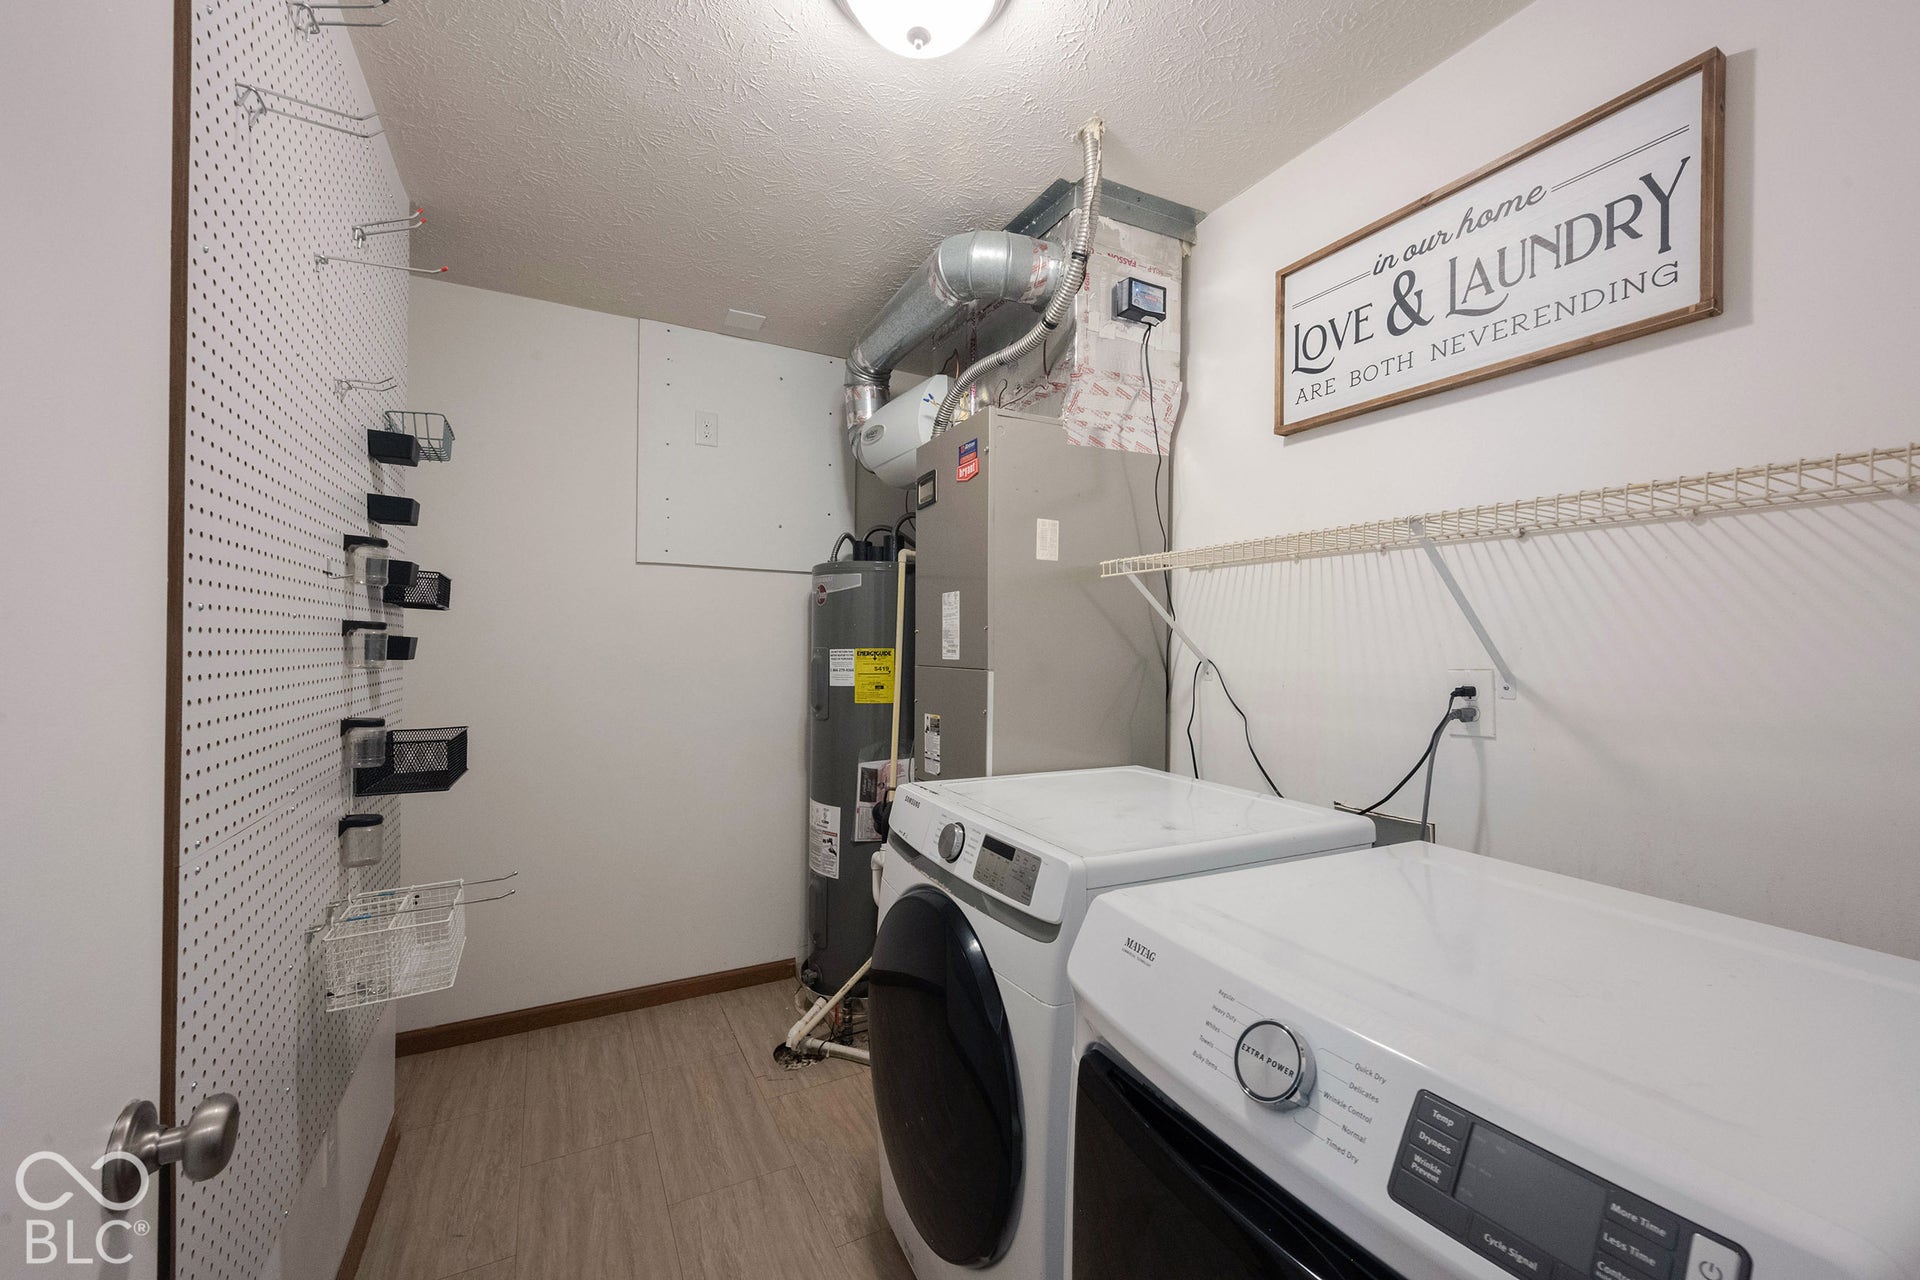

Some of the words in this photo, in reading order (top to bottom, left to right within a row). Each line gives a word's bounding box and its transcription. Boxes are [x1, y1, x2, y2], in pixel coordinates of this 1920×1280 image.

[1373, 254, 1399, 275] in
[1403, 231, 1453, 261] our
[1456, 185, 1547, 239] home
[1292, 303, 1374, 374] LOVE
[1386, 270, 1434, 336] &
[1446, 155, 1690, 318] LAUNDRY
[1295, 378, 1336, 405] ARE
[1350, 351, 1414, 387] BOTH
[1430, 261, 1679, 362] NEVERENDING
[905, 794, 921, 808] SAMSUNG
[1125, 937, 1157, 962] MAYTAG
[1218, 989, 1236, 1002] Regular
[1212, 1004, 1226, 1017] Heavy
[1226, 1012, 1237, 1023] Duty
[1205, 1020, 1220, 1033] Whites
[1200, 1034, 1214, 1048] Towels
[1205, 1058, 1218, 1070] Items
[1241, 1043, 1265, 1061] EXTRA
[1266, 1057, 1295, 1078] POWER
[1355, 1063, 1373, 1078] Quick
[1374, 1073, 1387, 1085] Dry
[1348, 1081, 1380, 1104] Delicates
[1323, 1091, 1347, 1110] Wrinkle
[1347, 1105, 1373, 1125] Control
[1433, 1109, 1455, 1127] Temp
[1341, 1124, 1367, 1144] Normal
[1418, 1131, 1452, 1155] Dryness
[1326, 1137, 1346, 1156] Timed
[1346, 1151, 1360, 1164] Dry
[1411, 1161, 1440, 1184] Prevent
[1414, 1153, 1442, 1176] Wrinkle
[1610, 1202, 1638, 1223] More
[1639, 1216, 1667, 1238] Time
[1484, 1233, 1507, 1252] Cycle
[1508, 1247, 1538, 1271] Signal
[1603, 1232, 1627, 1251] Less
[1629, 1245, 1656, 1267] Time
